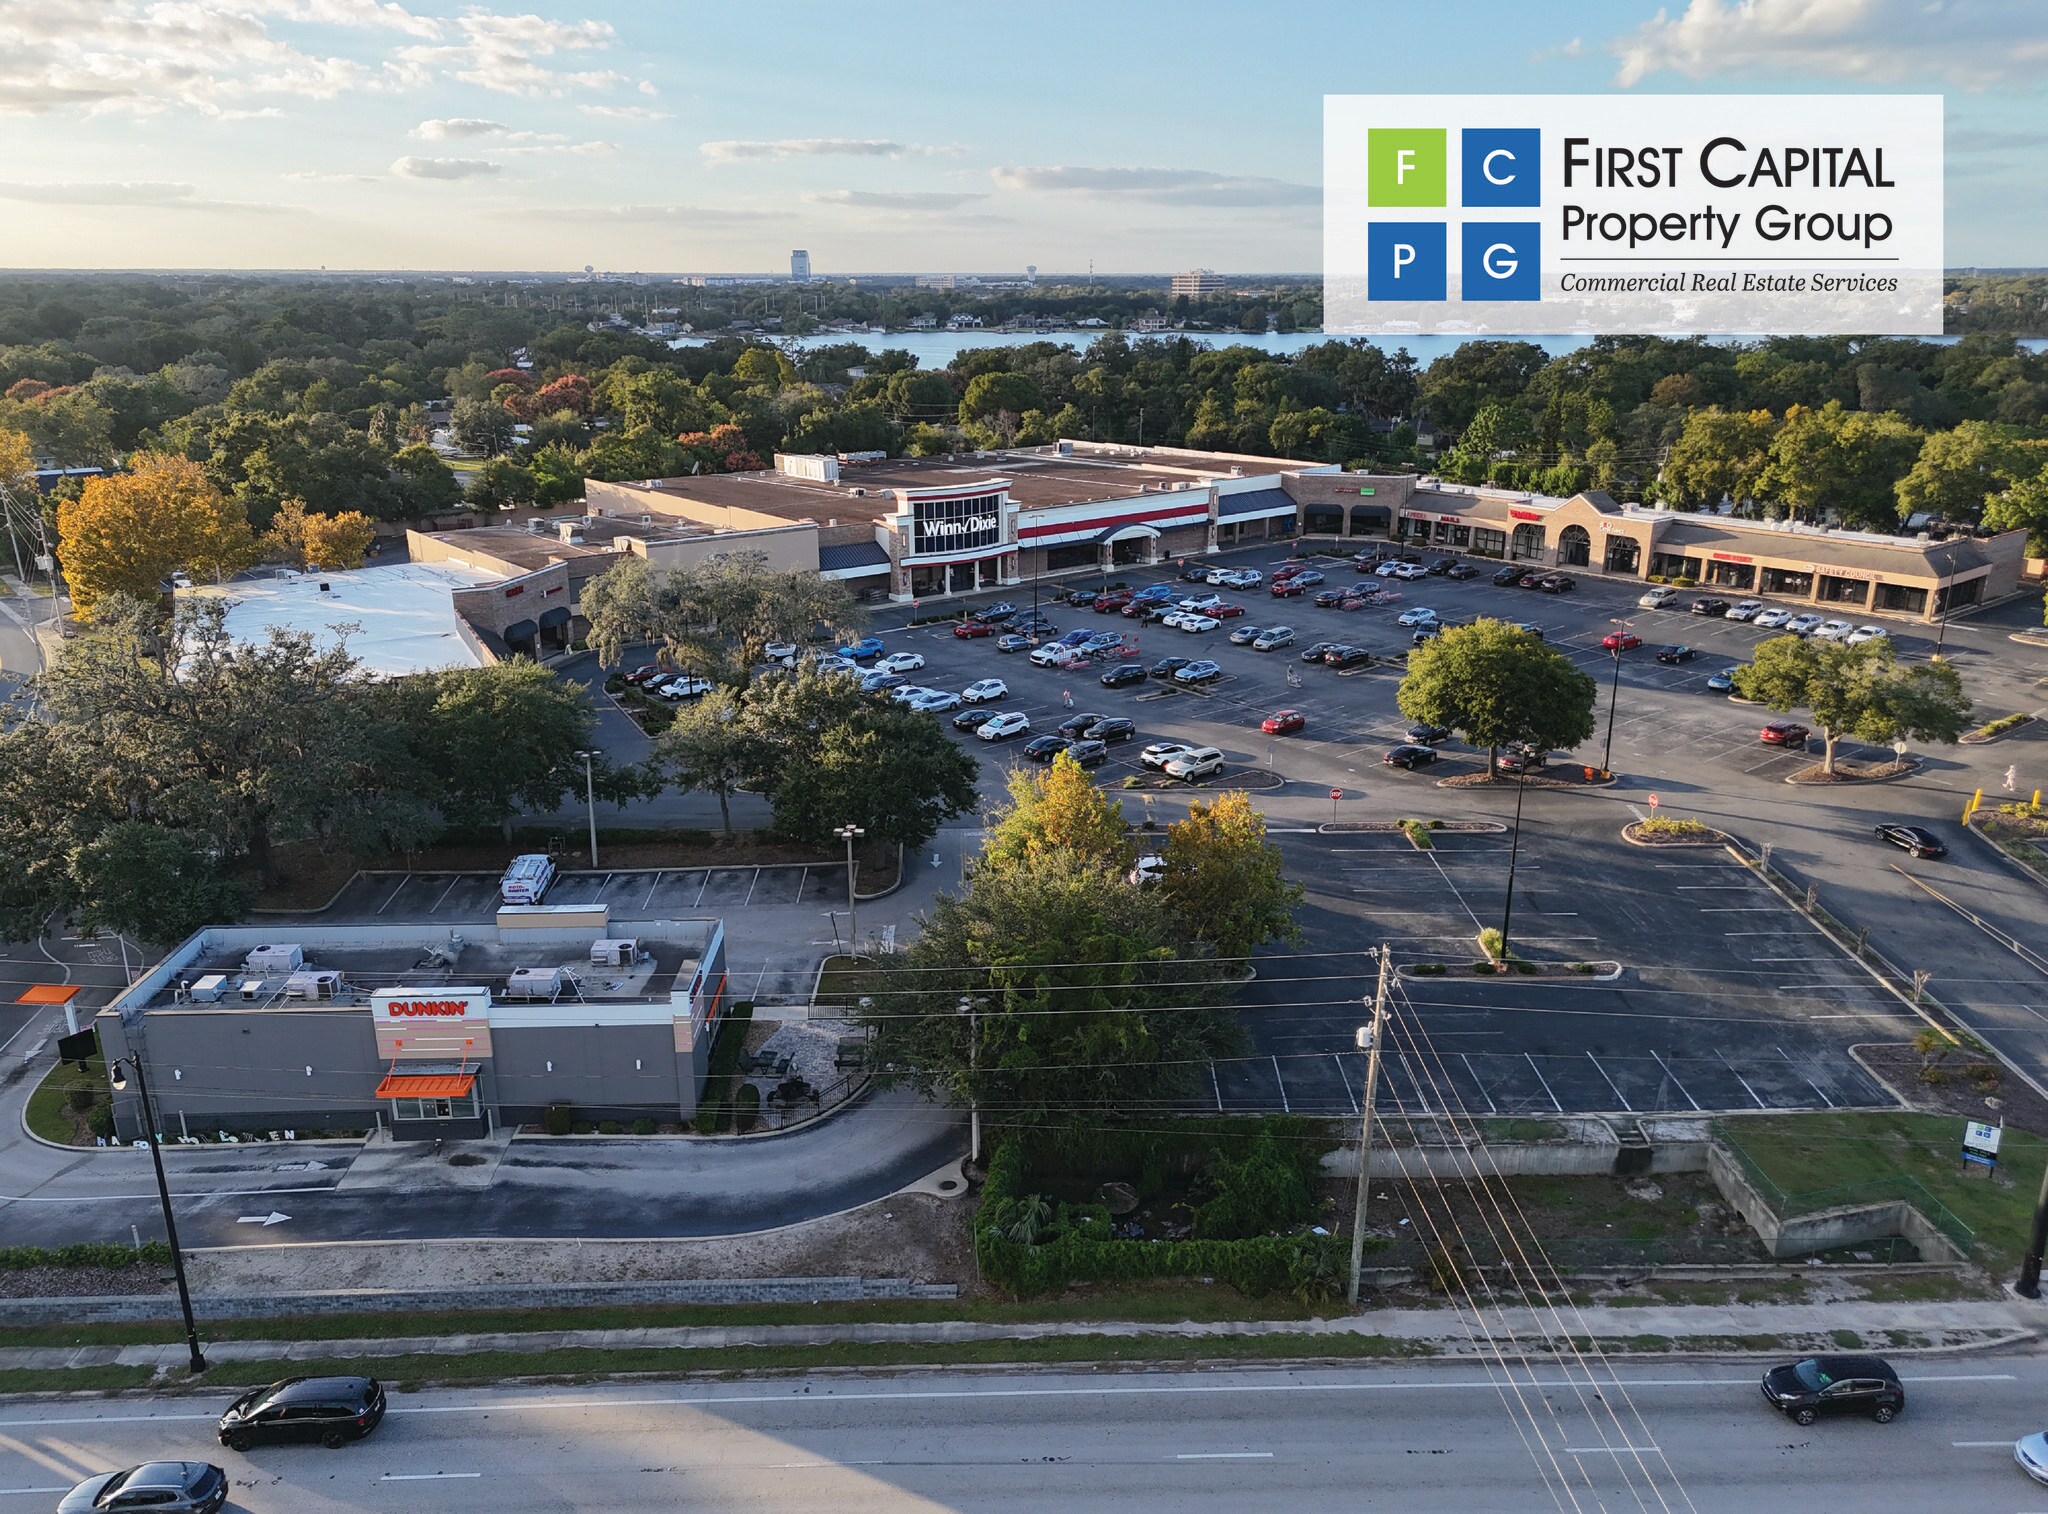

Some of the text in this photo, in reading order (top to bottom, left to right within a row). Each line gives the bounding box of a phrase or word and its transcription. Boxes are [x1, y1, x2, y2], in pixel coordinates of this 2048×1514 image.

[1815, 566, 1844, 576] SAFETY
[1845, 570, 1876, 580] COUNCIL
[388, 1001, 468, 1016] DUNKIN'
